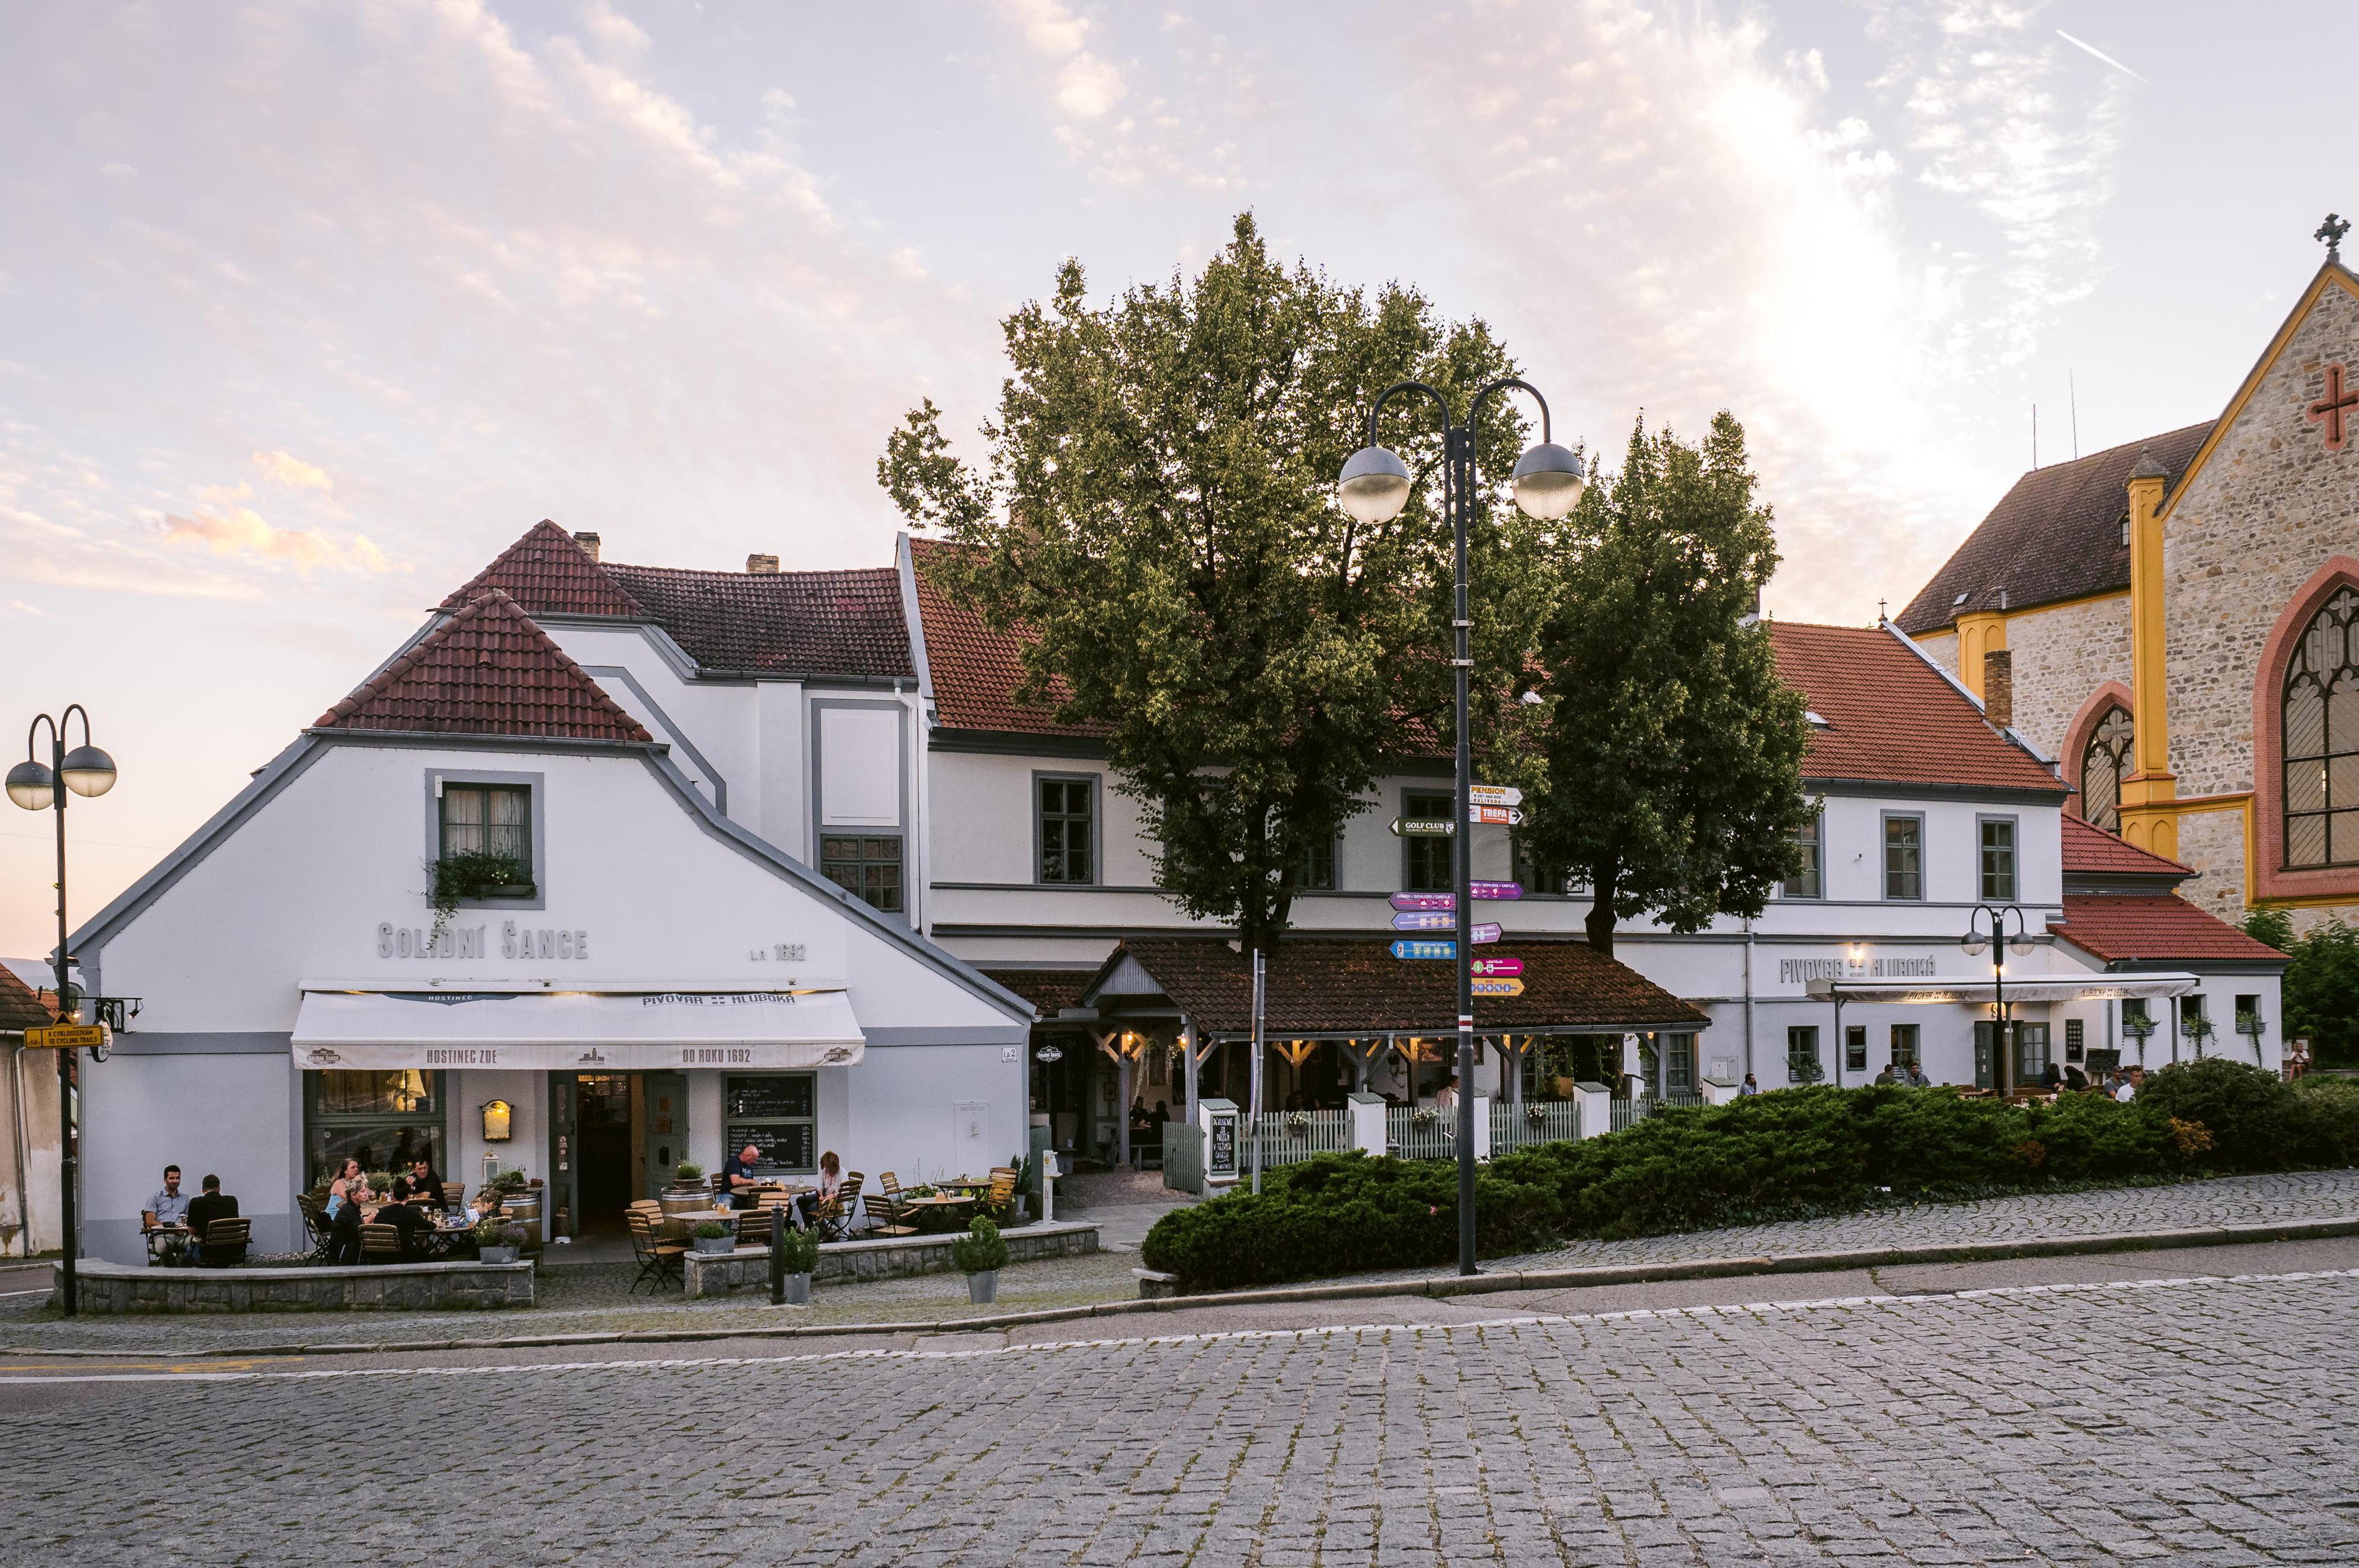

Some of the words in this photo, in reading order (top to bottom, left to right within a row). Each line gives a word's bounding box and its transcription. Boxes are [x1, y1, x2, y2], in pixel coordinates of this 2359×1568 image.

[1471, 786, 1505, 795] PENSION
[1482, 808, 1507, 817] TREFA
[378, 921, 486, 958] SOLIDNÍ
[502, 920, 588, 959] ŠANCE
[774, 943, 806, 961] 1692
[1781, 959, 1843, 983] PIVOVAR
[643, 994, 704, 1006] PIVOVAR
[731, 993, 795, 1004] HLUBOKÁ
[1907, 991, 1933, 1000] PIVOVAR
[427, 1050, 475, 1064] HOSTINEC
[480, 1049, 497, 1064] ZDE
[683, 1049, 695, 1063] OD
[699, 1049, 724, 1063] ROKU
[727, 1049, 750, 1063] 1692
[1011, 1049, 1015, 1057] 2
